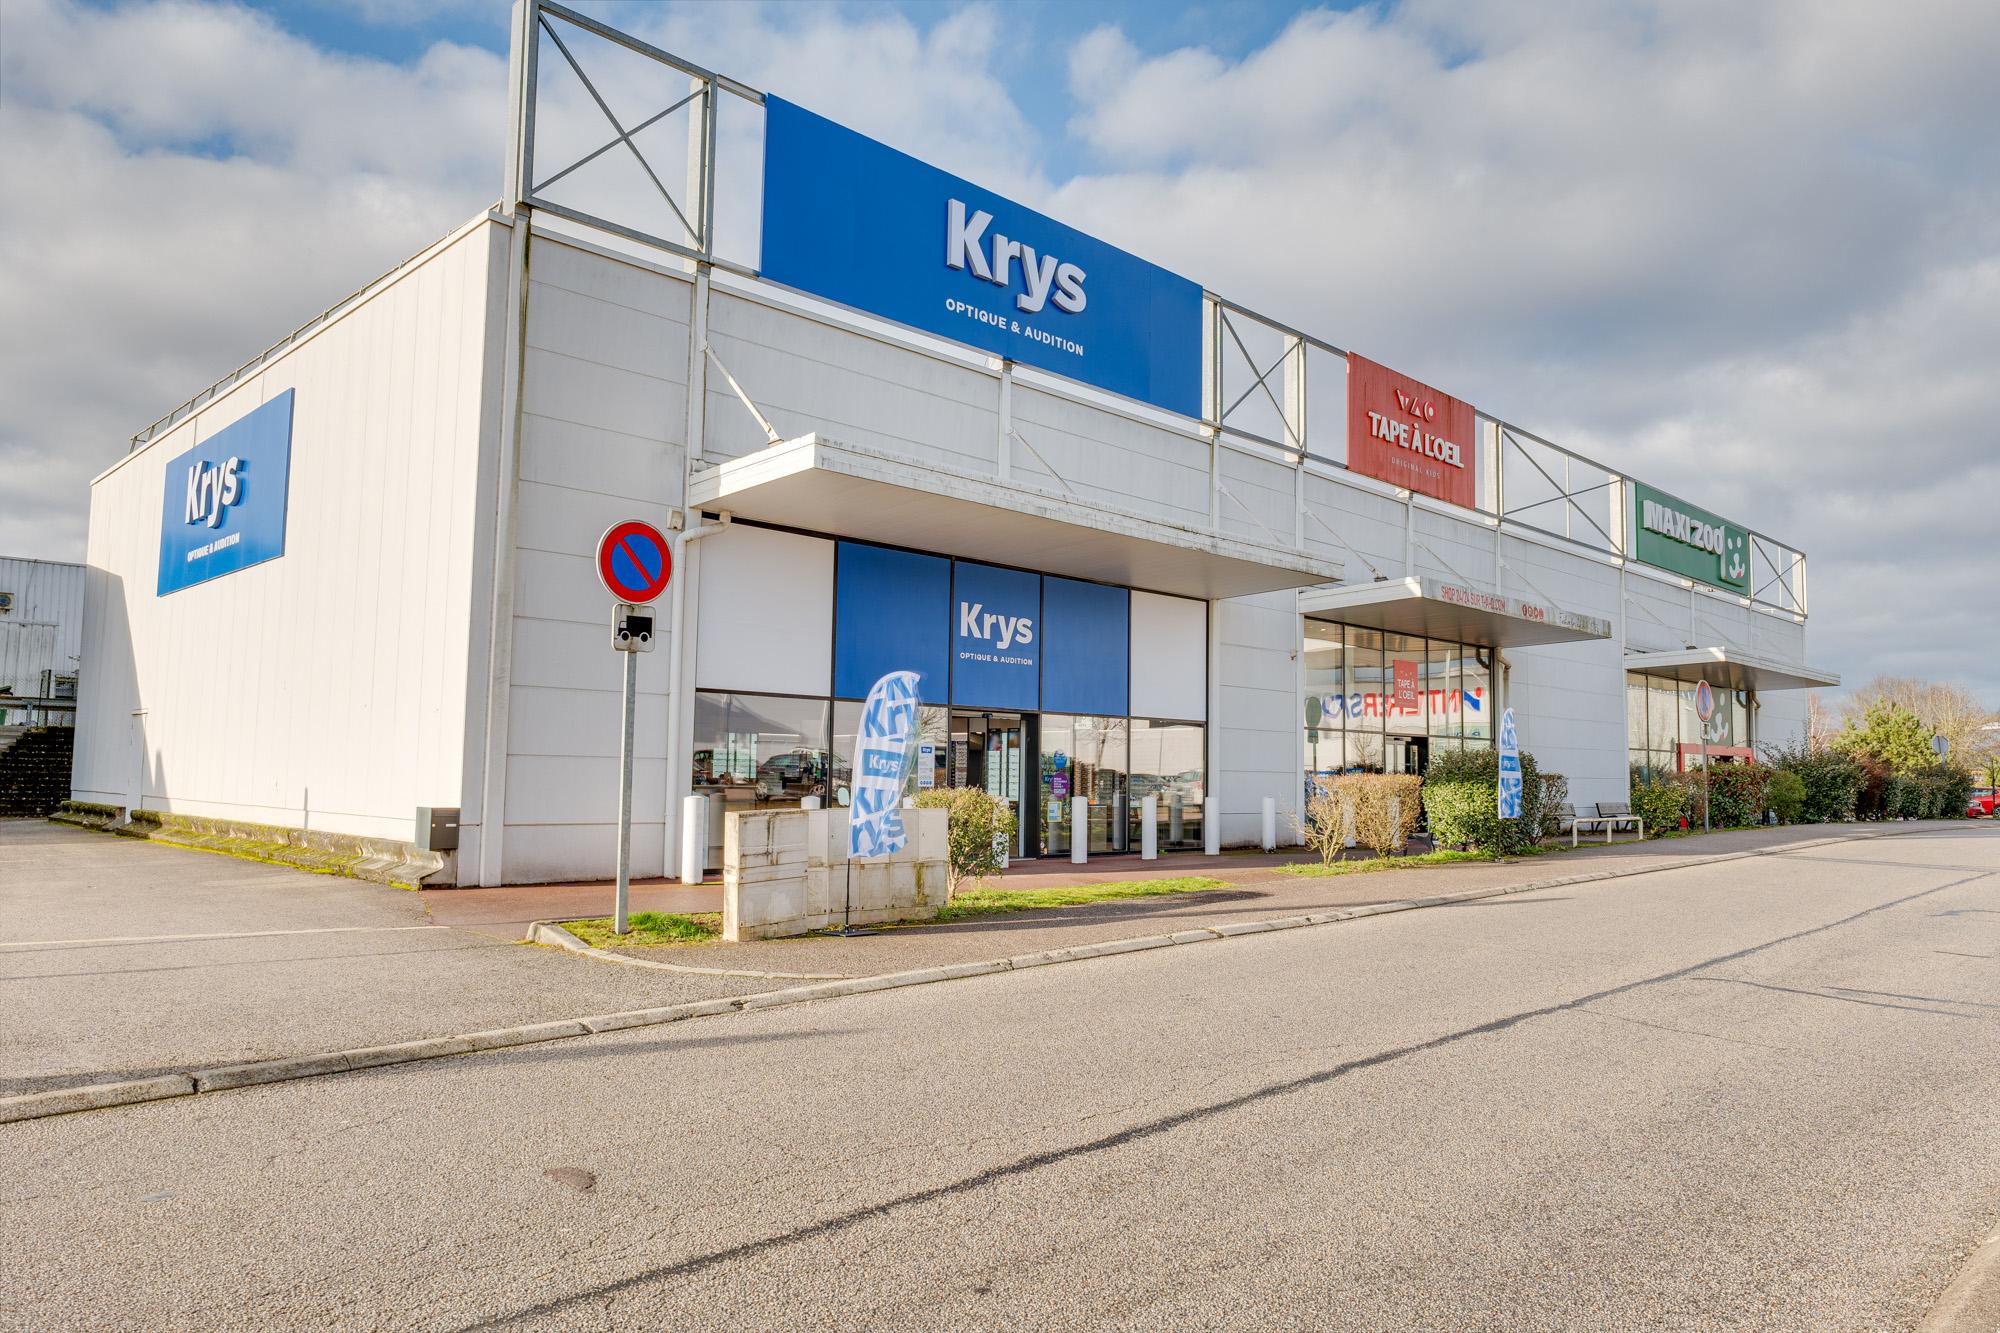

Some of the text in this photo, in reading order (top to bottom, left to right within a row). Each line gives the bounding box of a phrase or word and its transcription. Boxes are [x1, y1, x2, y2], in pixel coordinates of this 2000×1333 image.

[947, 198, 1087, 313] Krys
[946, 299, 1084, 356] OPTIQUE & AUDITION
[1367, 411, 1409, 449] TAPE
[185, 456, 241, 529] Krys
[187, 545, 209, 562] OPTIQUE
[214, 532, 240, 552] AUDITION
[1643, 499, 1724, 555] MAXI ZOO
[960, 601, 1033, 650] Krys
[960, 652, 992, 662] OPTIQUE
[1000, 656, 1033, 666] AUDITION
[868, 753, 900, 774] Krys
